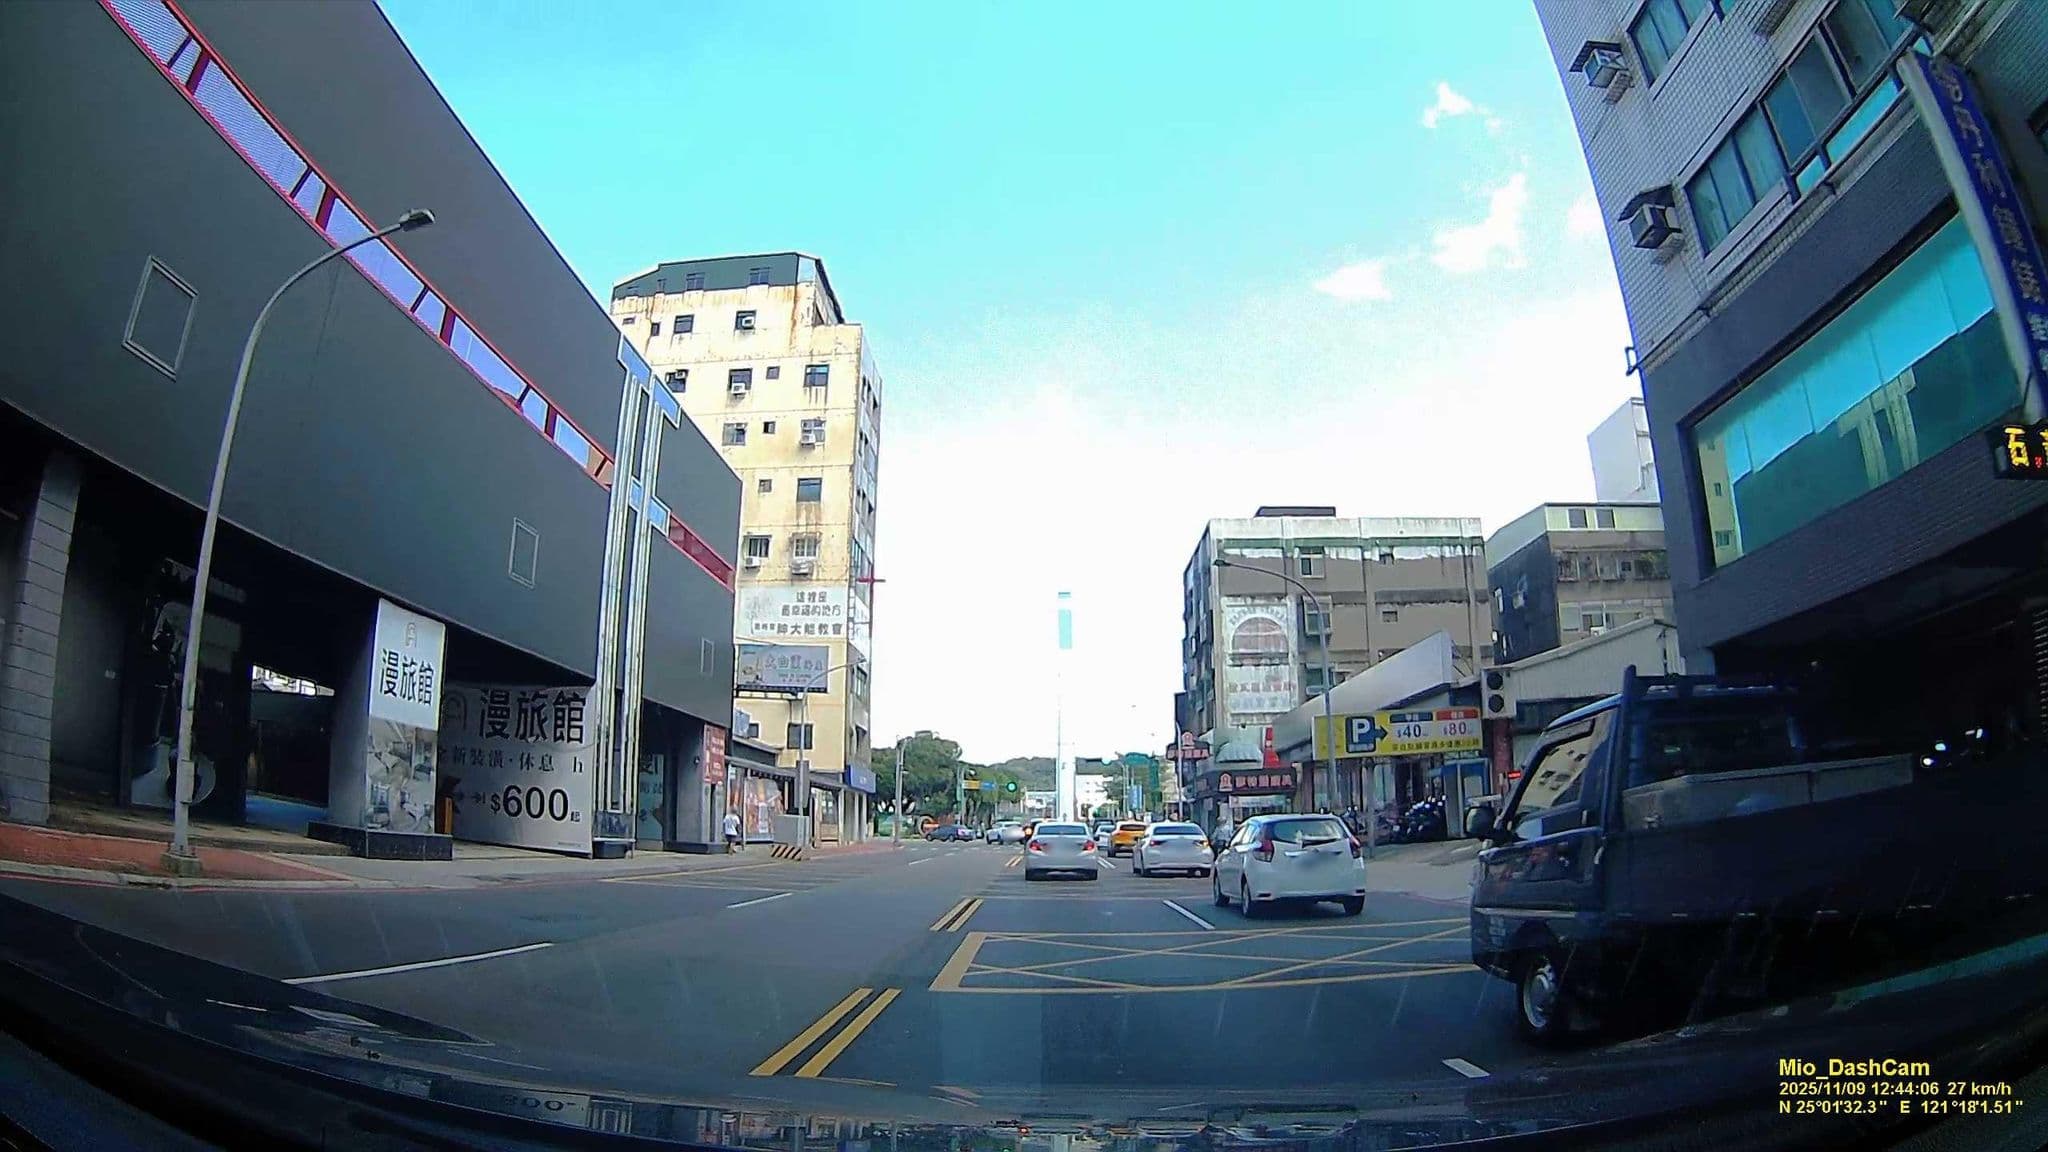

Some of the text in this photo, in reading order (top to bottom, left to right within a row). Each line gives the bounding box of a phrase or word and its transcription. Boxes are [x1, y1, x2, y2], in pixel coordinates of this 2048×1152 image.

[380, 648, 434, 707] 漫旅館
[479, 688, 586, 744] 漫旅館
[1352, 718, 1371, 743] P
